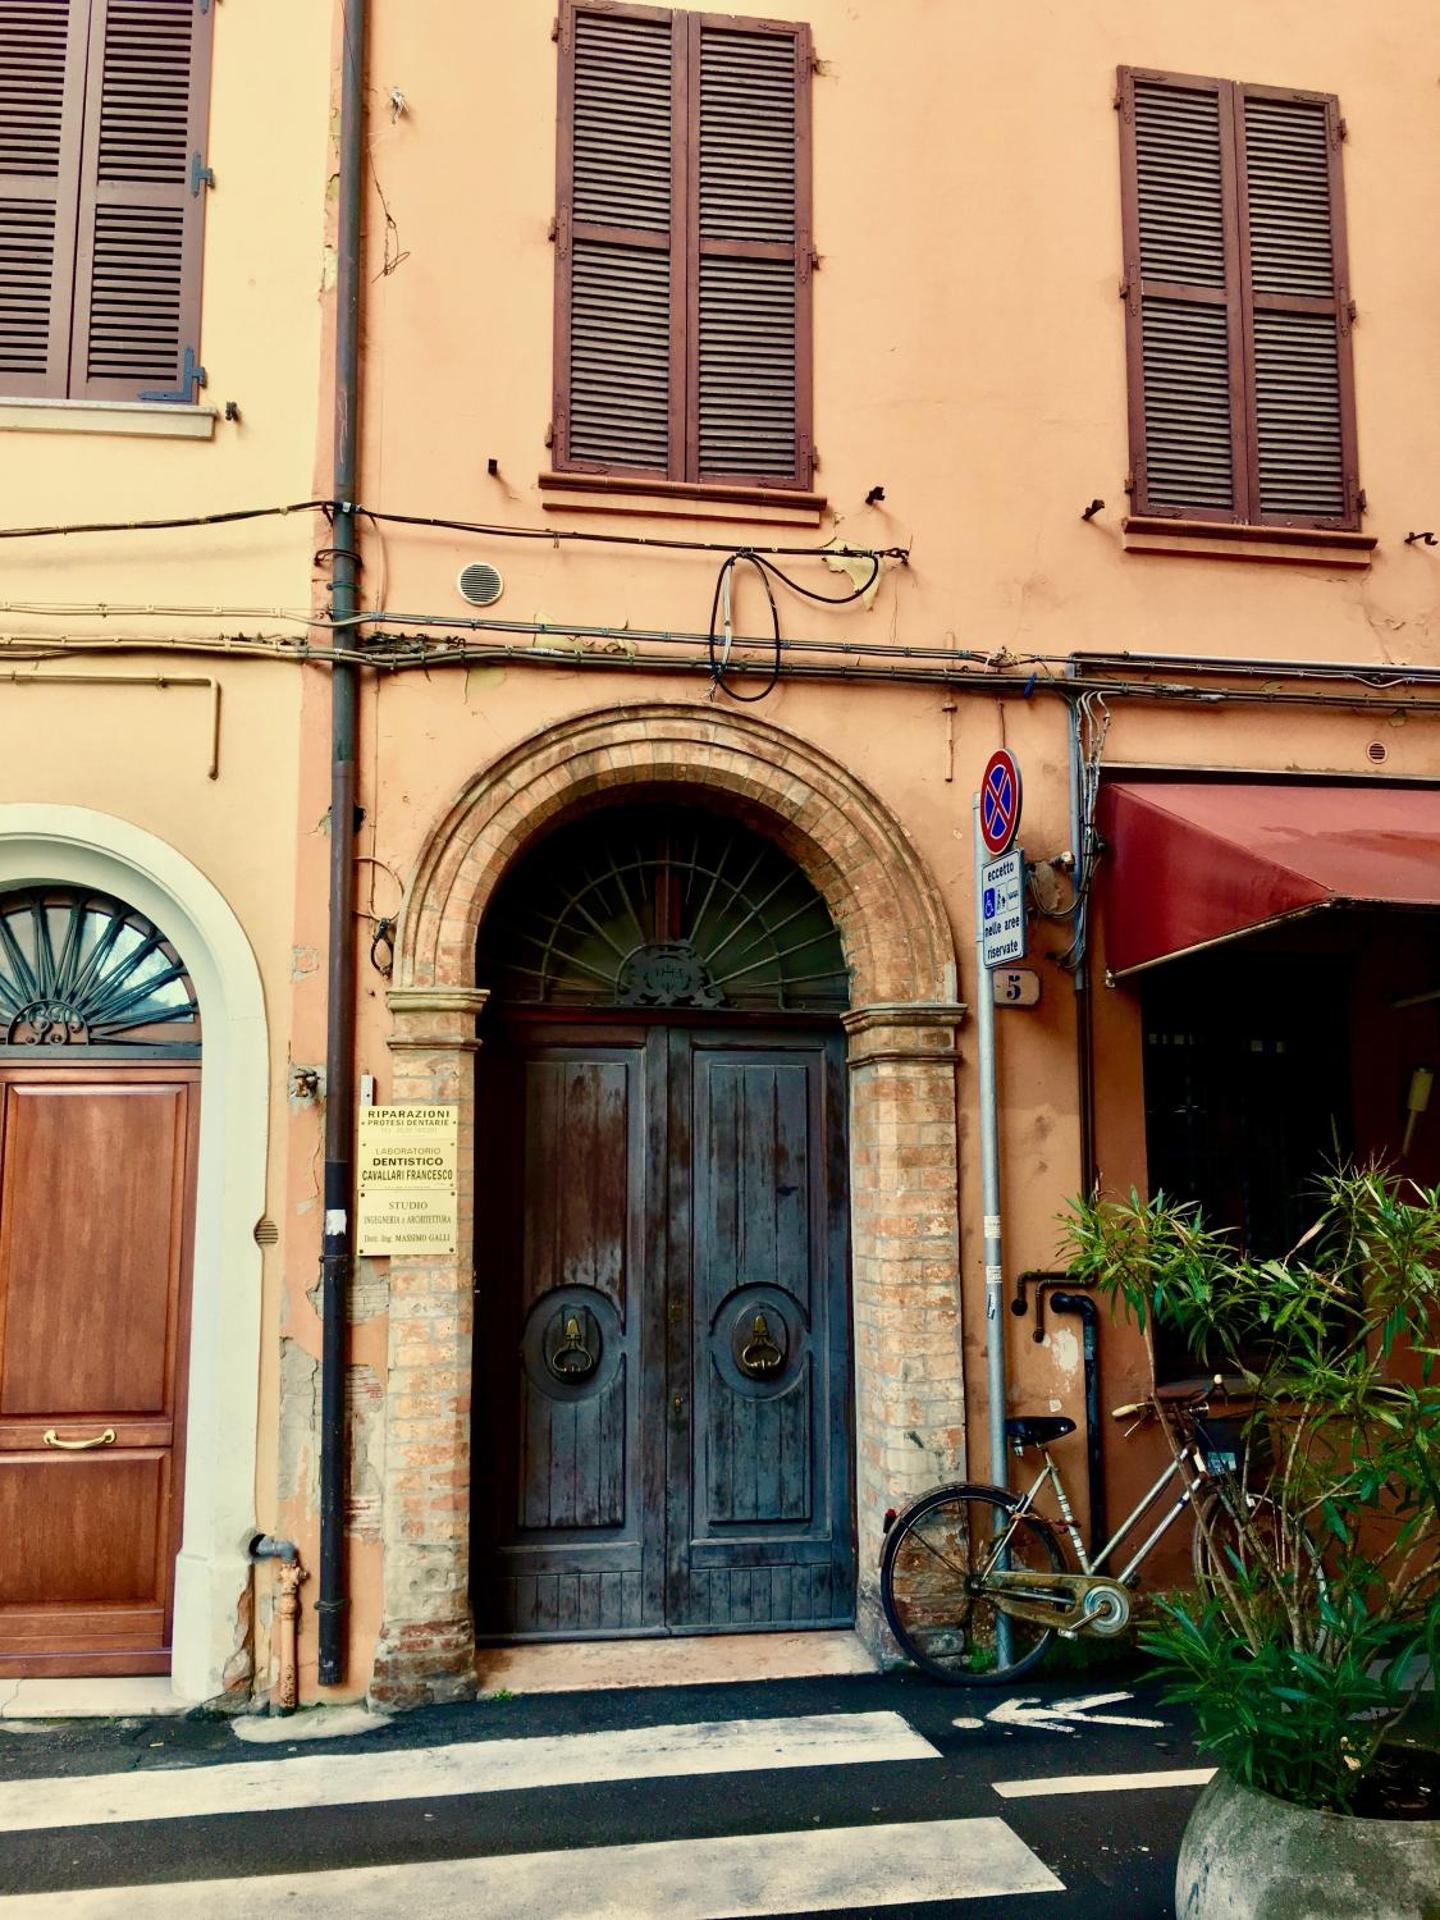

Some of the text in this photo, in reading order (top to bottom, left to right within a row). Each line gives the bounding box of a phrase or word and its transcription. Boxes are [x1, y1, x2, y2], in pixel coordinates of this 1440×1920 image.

[987, 861, 1014, 882] eccetto
[985, 915, 1020, 938] nelle aree
[987, 939, 1018, 960] riservate
[1006, 974, 1021, 1000] 5
[367, 1110, 450, 1118] RIPARAZIONI
[375, 1147, 441, 1156] LABORATORIO
[372, 1157, 444, 1167] DENTISTICO
[362, 1169, 453, 1181] CAVALLARI FRANCESCO
[388, 1201, 428, 1210] STUDIO
[363, 1215, 400, 1225] INGEGNERIA
[406, 1215, 452, 1224] ARCHITETTURA
[395, 1234, 427, 1242] MASSIMO
[428, 1233, 450, 1242] GALLI
